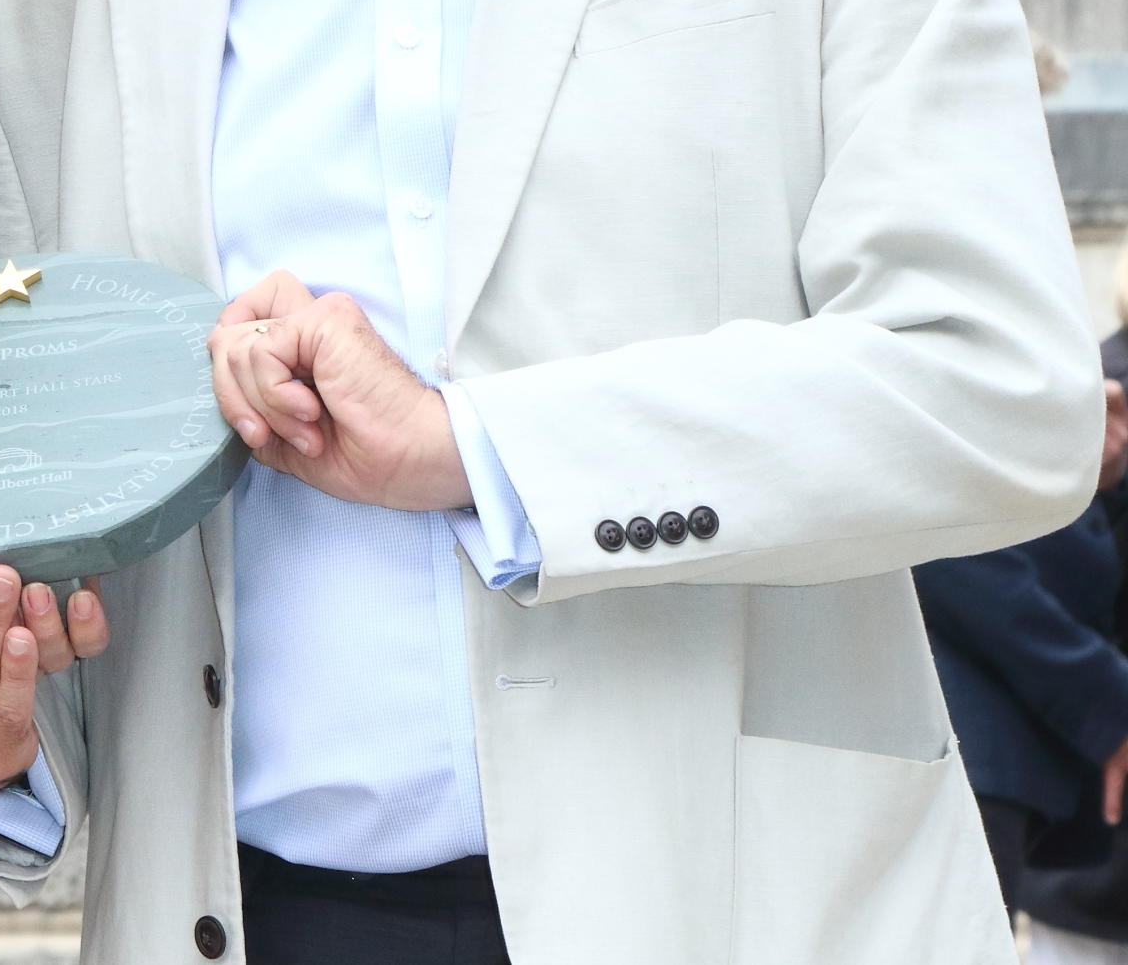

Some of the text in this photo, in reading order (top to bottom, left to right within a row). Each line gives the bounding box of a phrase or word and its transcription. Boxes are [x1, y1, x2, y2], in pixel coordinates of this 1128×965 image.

[70, 274, 156, 306] HOME
[154, 299, 186, 323] TO
[1, 339, 78, 361] PROMS
[181, 323, 207, 360] THE
[26, 381, 67, 396] HALL
[73, 373, 122, 388] STARS
[41, 470, 73, 484] Hall
[48, 456, 173, 530] GREATEST
